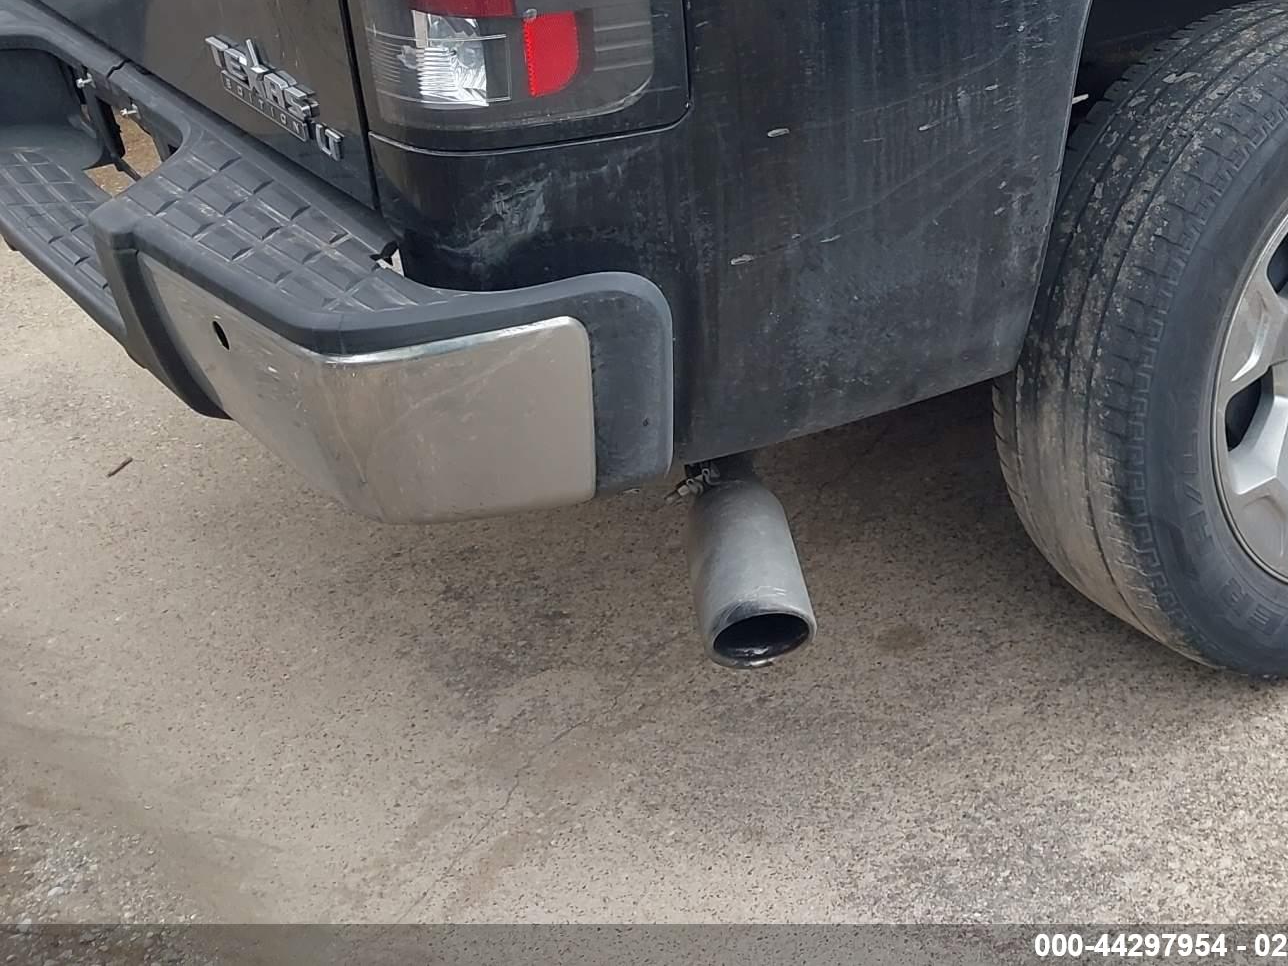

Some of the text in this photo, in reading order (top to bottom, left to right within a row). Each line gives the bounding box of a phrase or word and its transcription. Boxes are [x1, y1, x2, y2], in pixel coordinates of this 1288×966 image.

[205, 35, 320, 120] TEXAS
[224, 77, 303, 135] EDITION
[315, 122, 345, 162] LT
